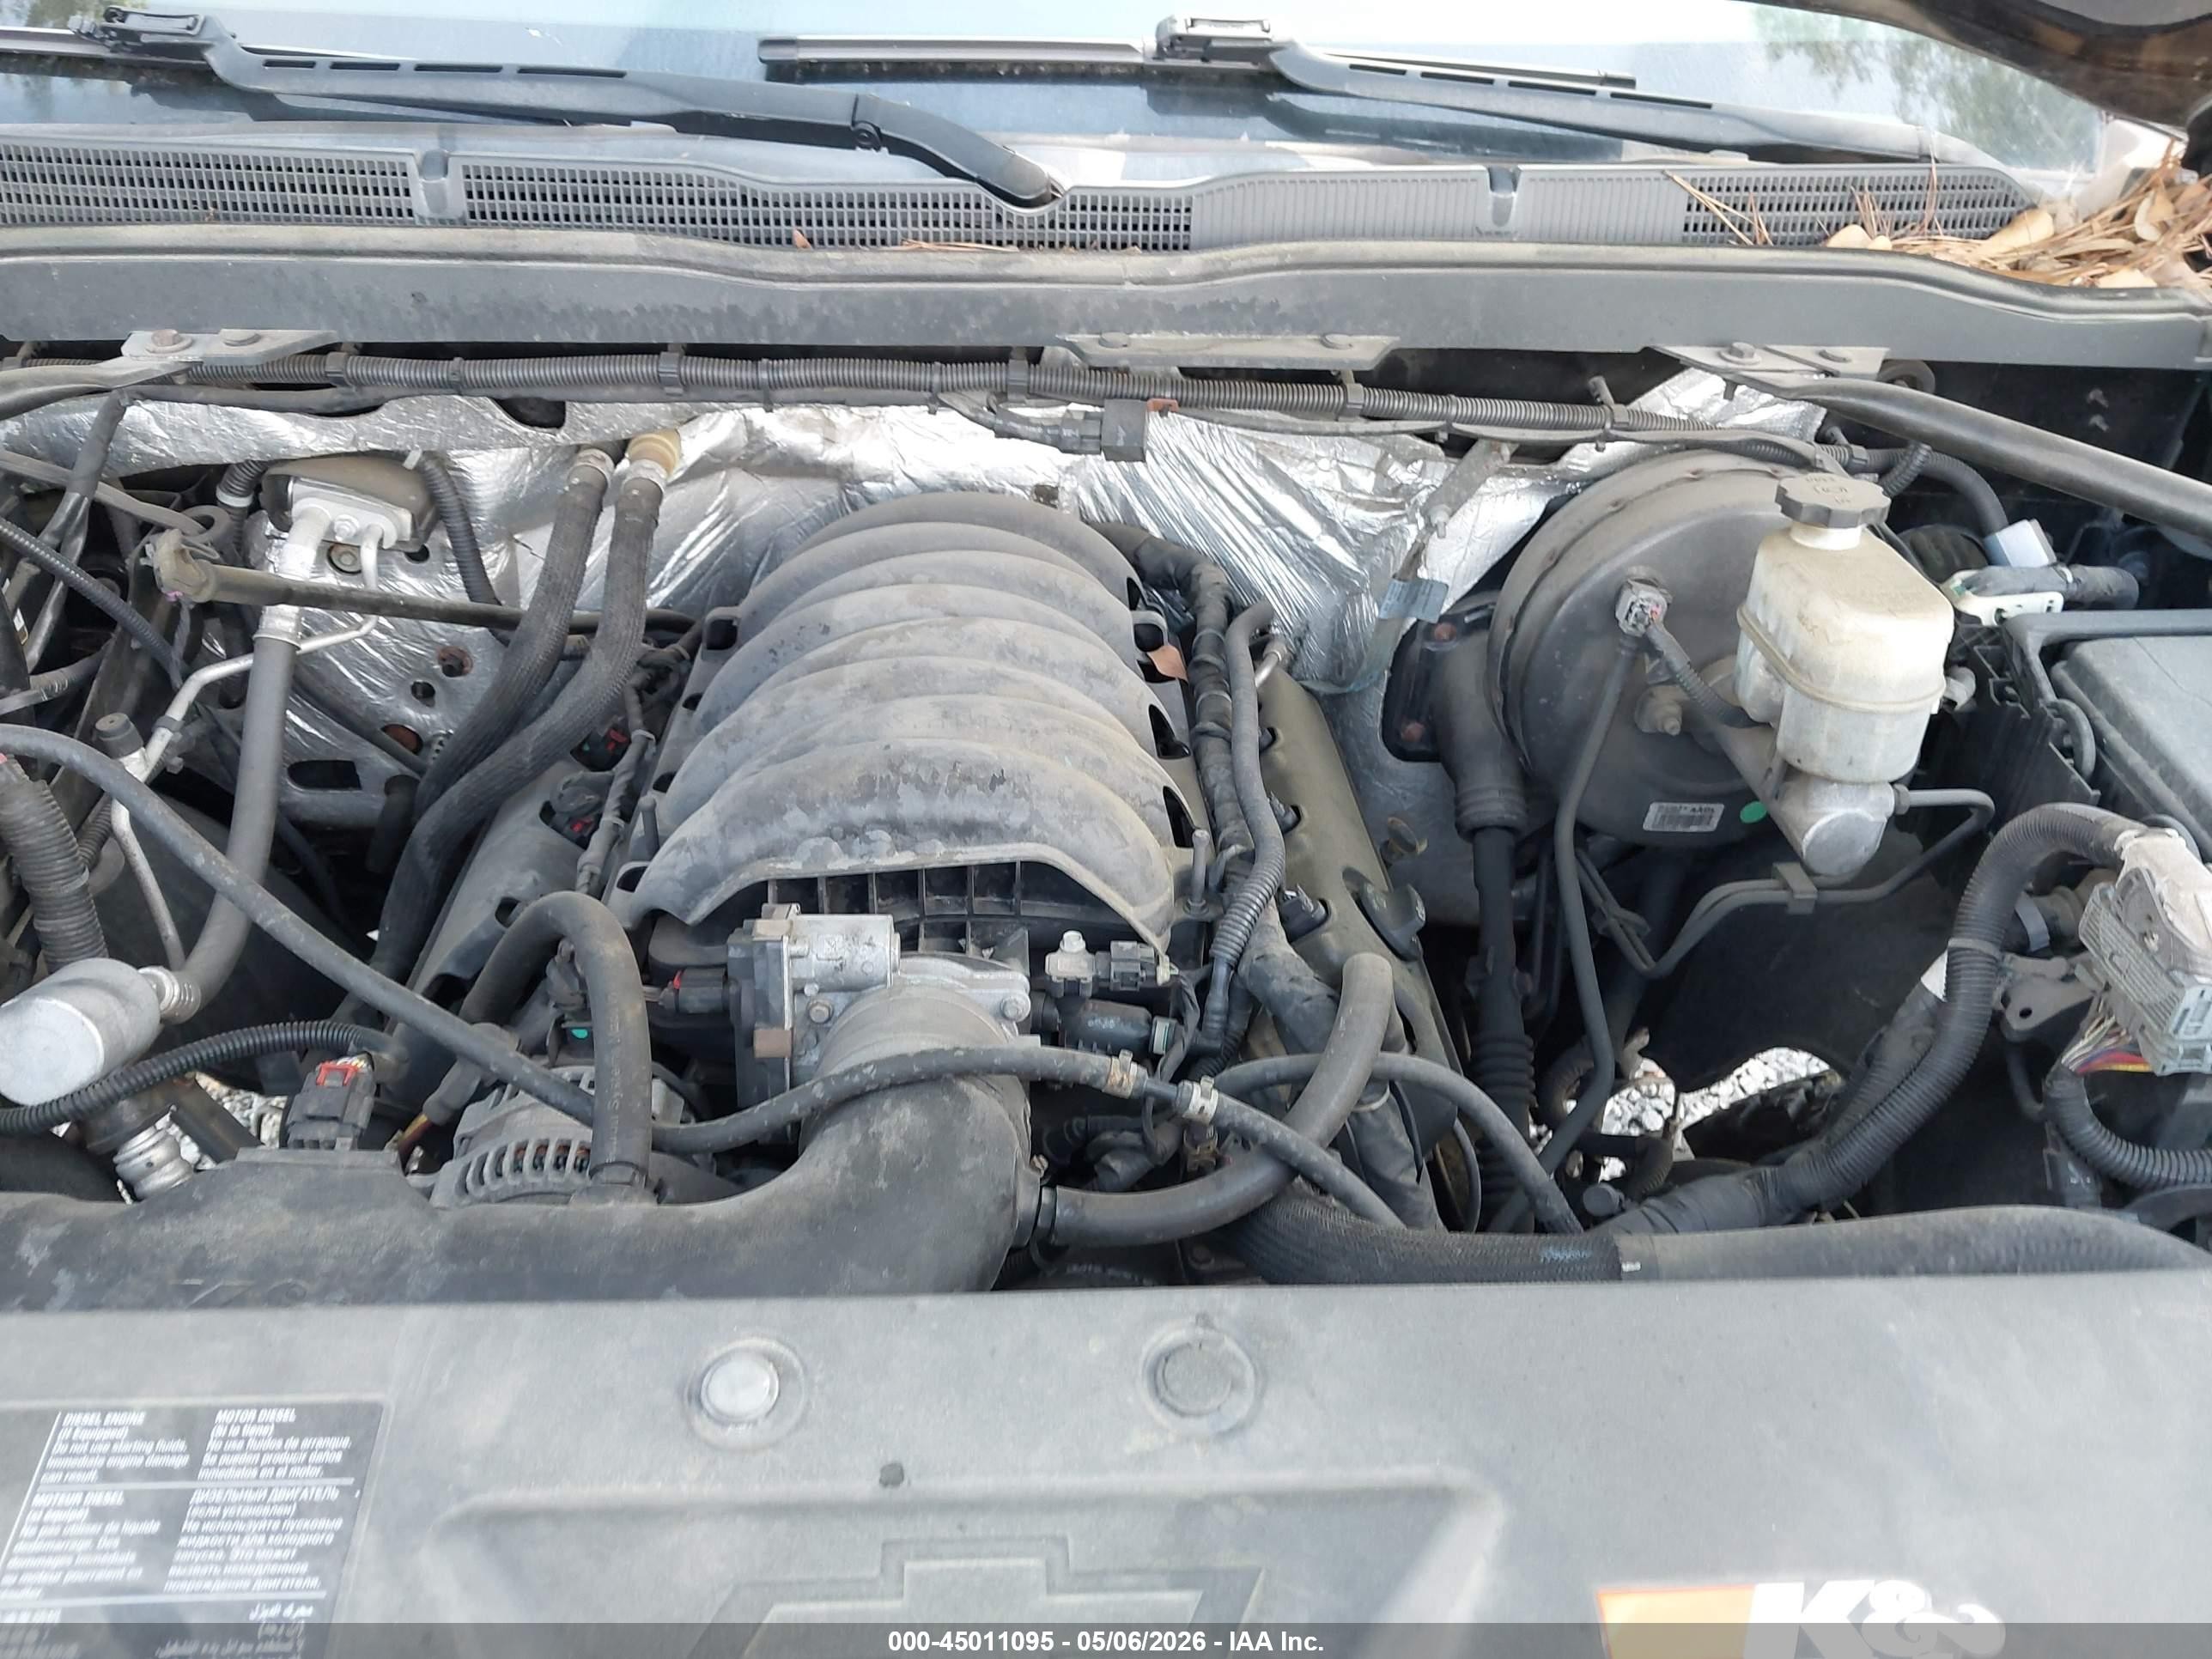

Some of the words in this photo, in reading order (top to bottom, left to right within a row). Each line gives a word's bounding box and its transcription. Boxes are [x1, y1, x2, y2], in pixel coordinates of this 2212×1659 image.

[62, 1413, 102, 1426] DIESEL
[103, 1411, 145, 1425] ENGINE
[215, 1409, 256, 1423] MOTOR
[257, 1408, 298, 1422] DIESEL
[110, 1440, 154, 1455] starting
[246, 1437, 283, 1449] fluidos
[143, 1454, 189, 1468] damage
[218, 1452, 259, 1465] pueden
[260, 1451, 306, 1465] producir
[32, 1492, 82, 1506] MOTEUR
[83, 1491, 125, 1504] DIESEL
[191, 1487, 267, 1503] ДИЗЕЛЬНЫЙ
[268, 1486, 339, 1501] ДВИГАТЕЛЬ
[281, 1517, 343, 1531] пусковые
